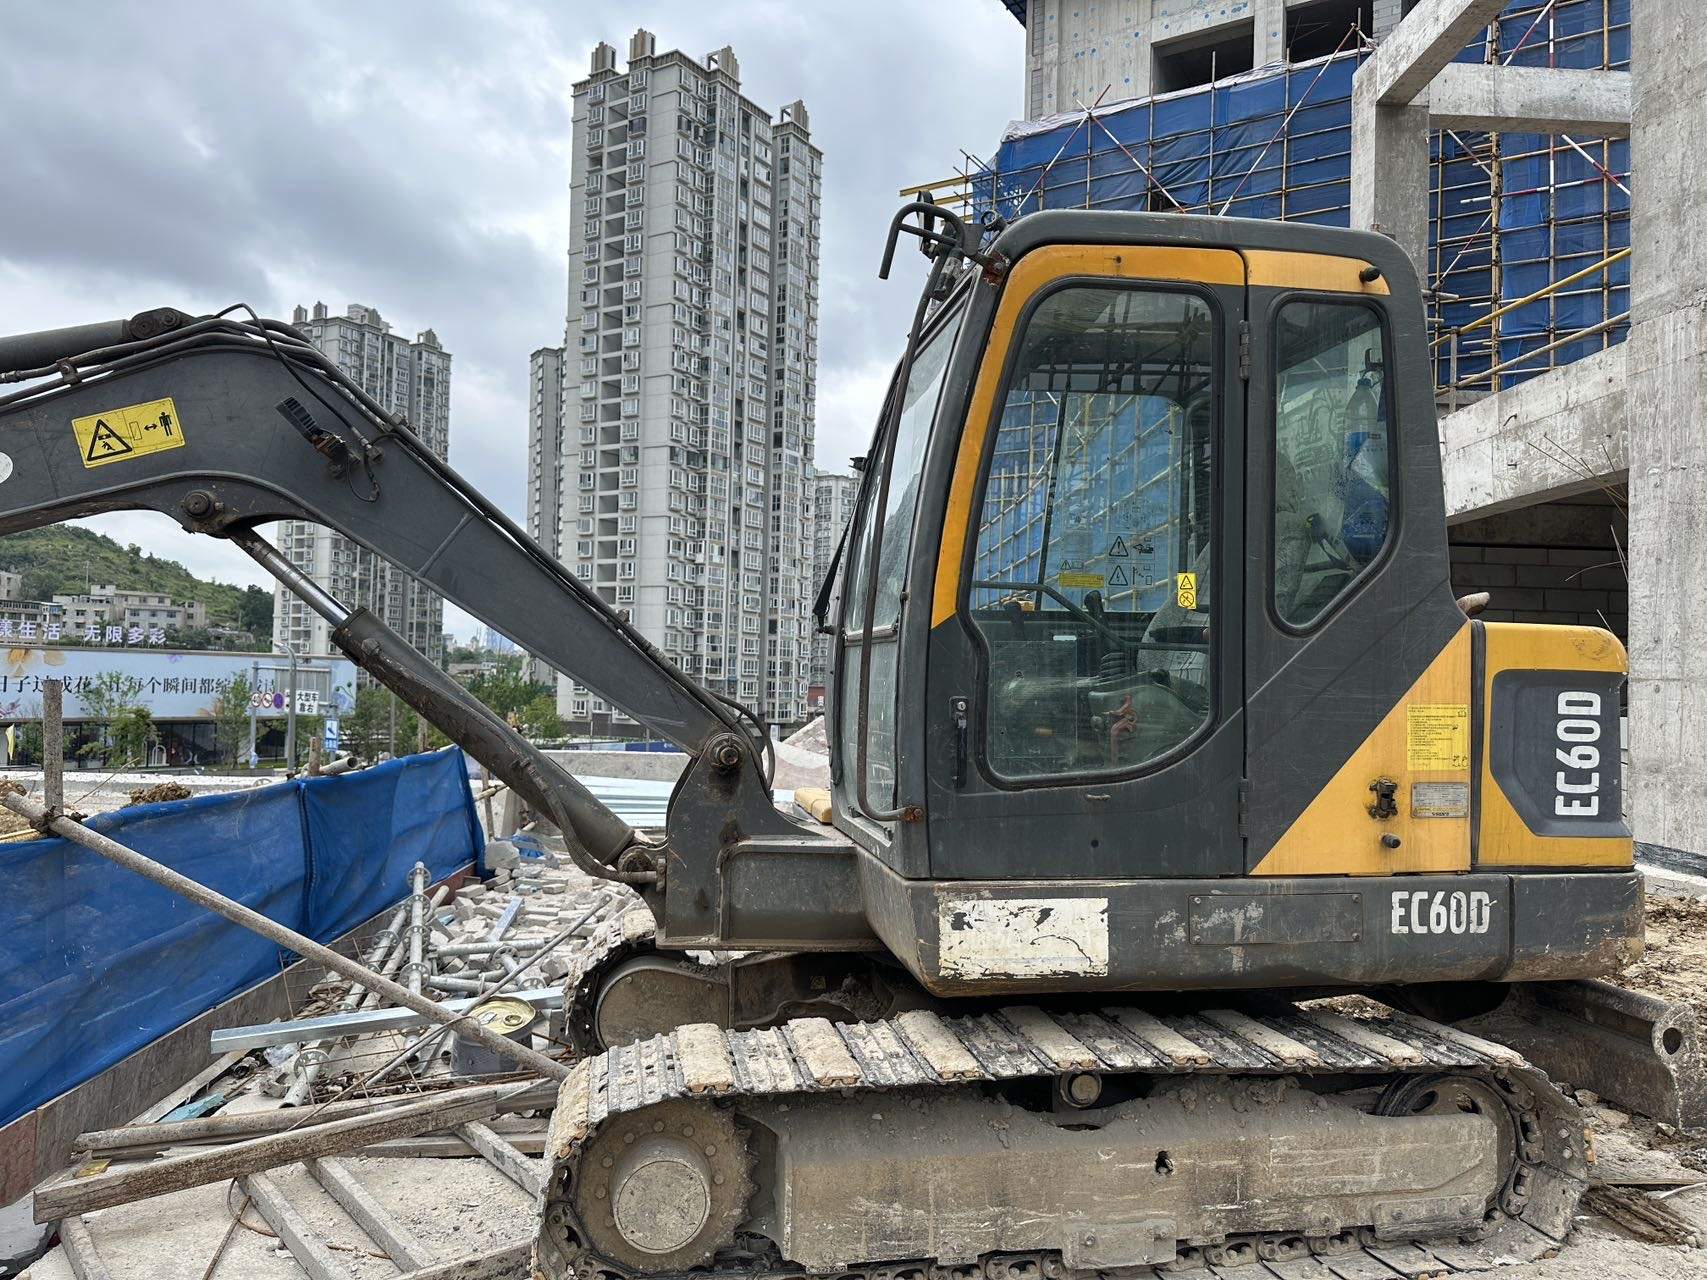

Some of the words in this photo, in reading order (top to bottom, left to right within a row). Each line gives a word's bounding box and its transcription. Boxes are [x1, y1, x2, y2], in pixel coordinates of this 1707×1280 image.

[84, 624, 167, 645] 无限多彩
[297, 692, 319, 702] 大型车
[299, 702, 314, 713] 靠右
[1555, 691, 1601, 816] EC60D
[1391, 891, 1490, 934] EC60D
